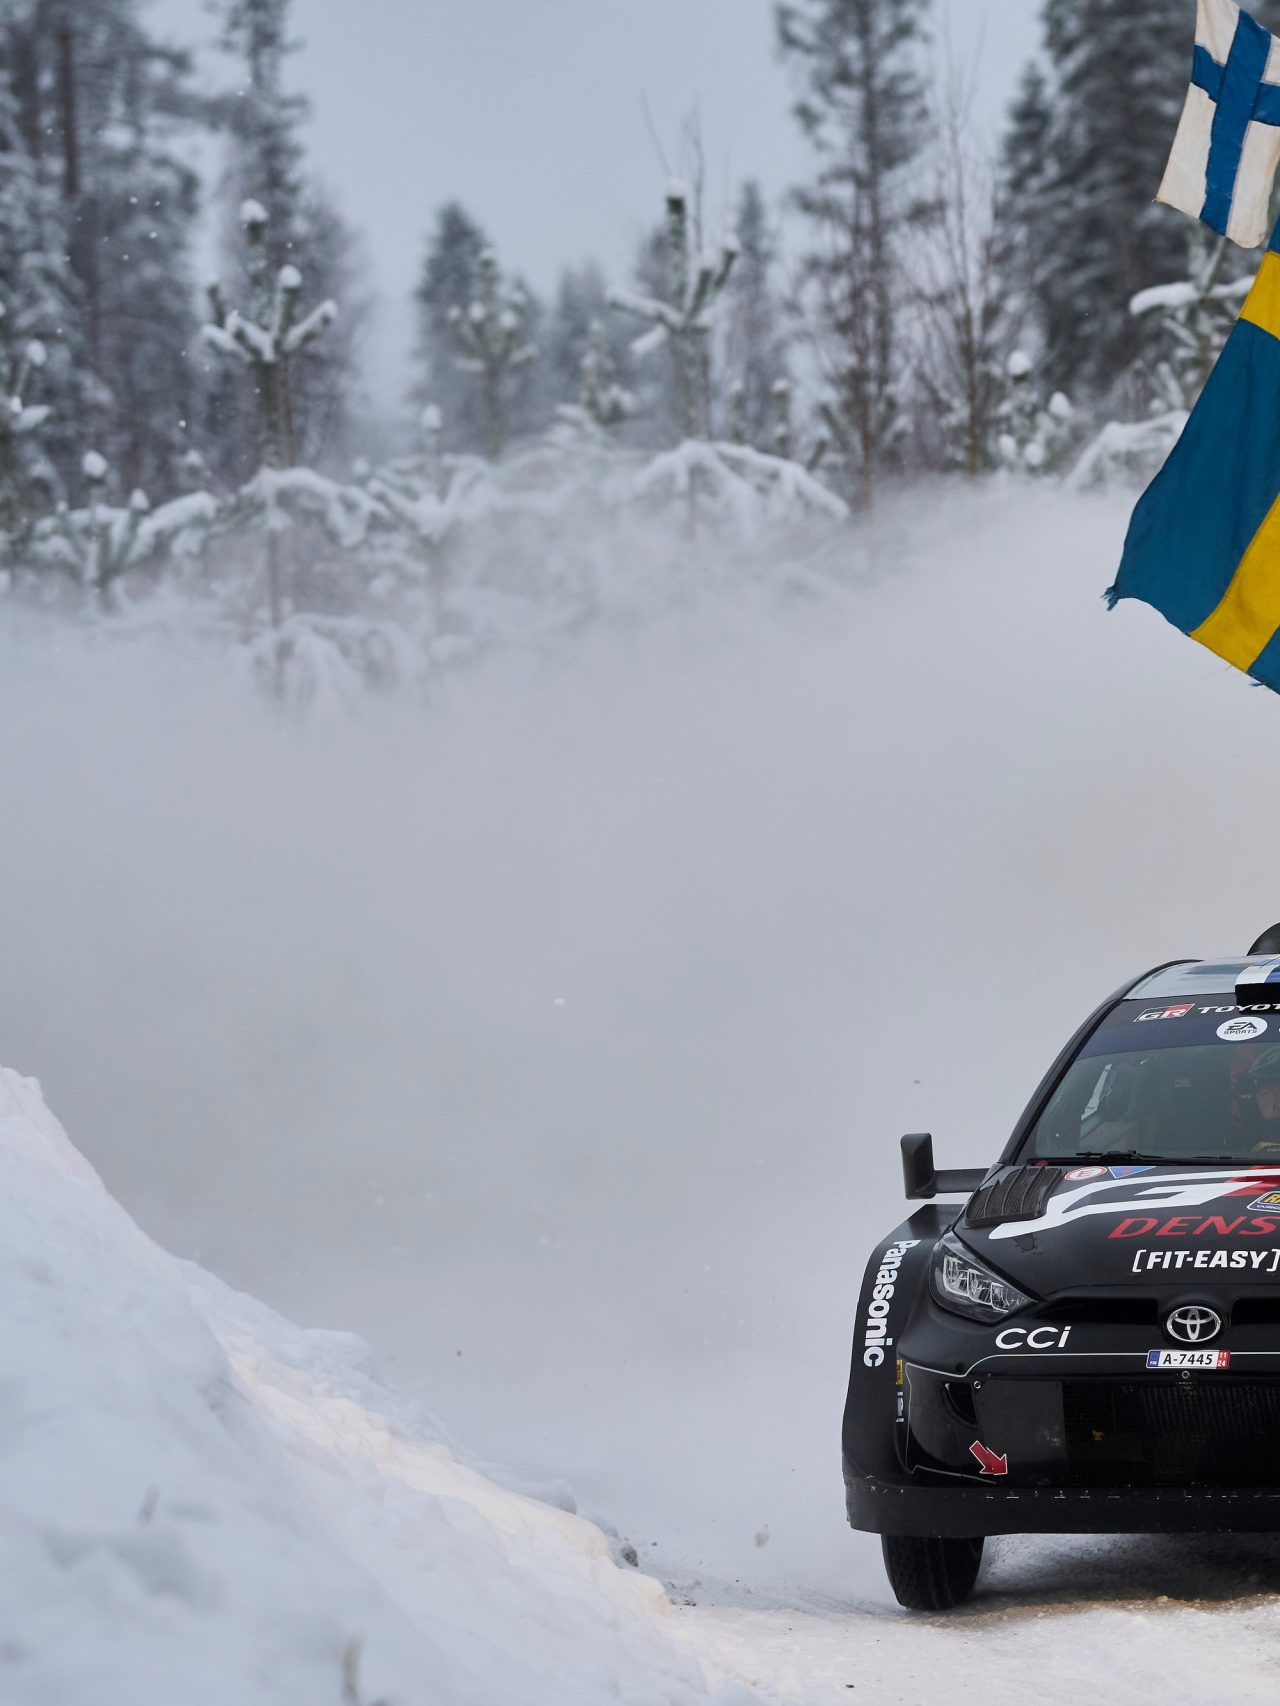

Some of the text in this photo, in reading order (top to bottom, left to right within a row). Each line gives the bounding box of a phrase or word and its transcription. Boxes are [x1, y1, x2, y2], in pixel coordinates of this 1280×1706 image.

[1136, 1006, 1190, 1021] GR
[1226, 1022, 1258, 1030] EA
[863, 1239, 921, 1368] Panasonic
[1163, 1353, 1213, 1365] A-7445
